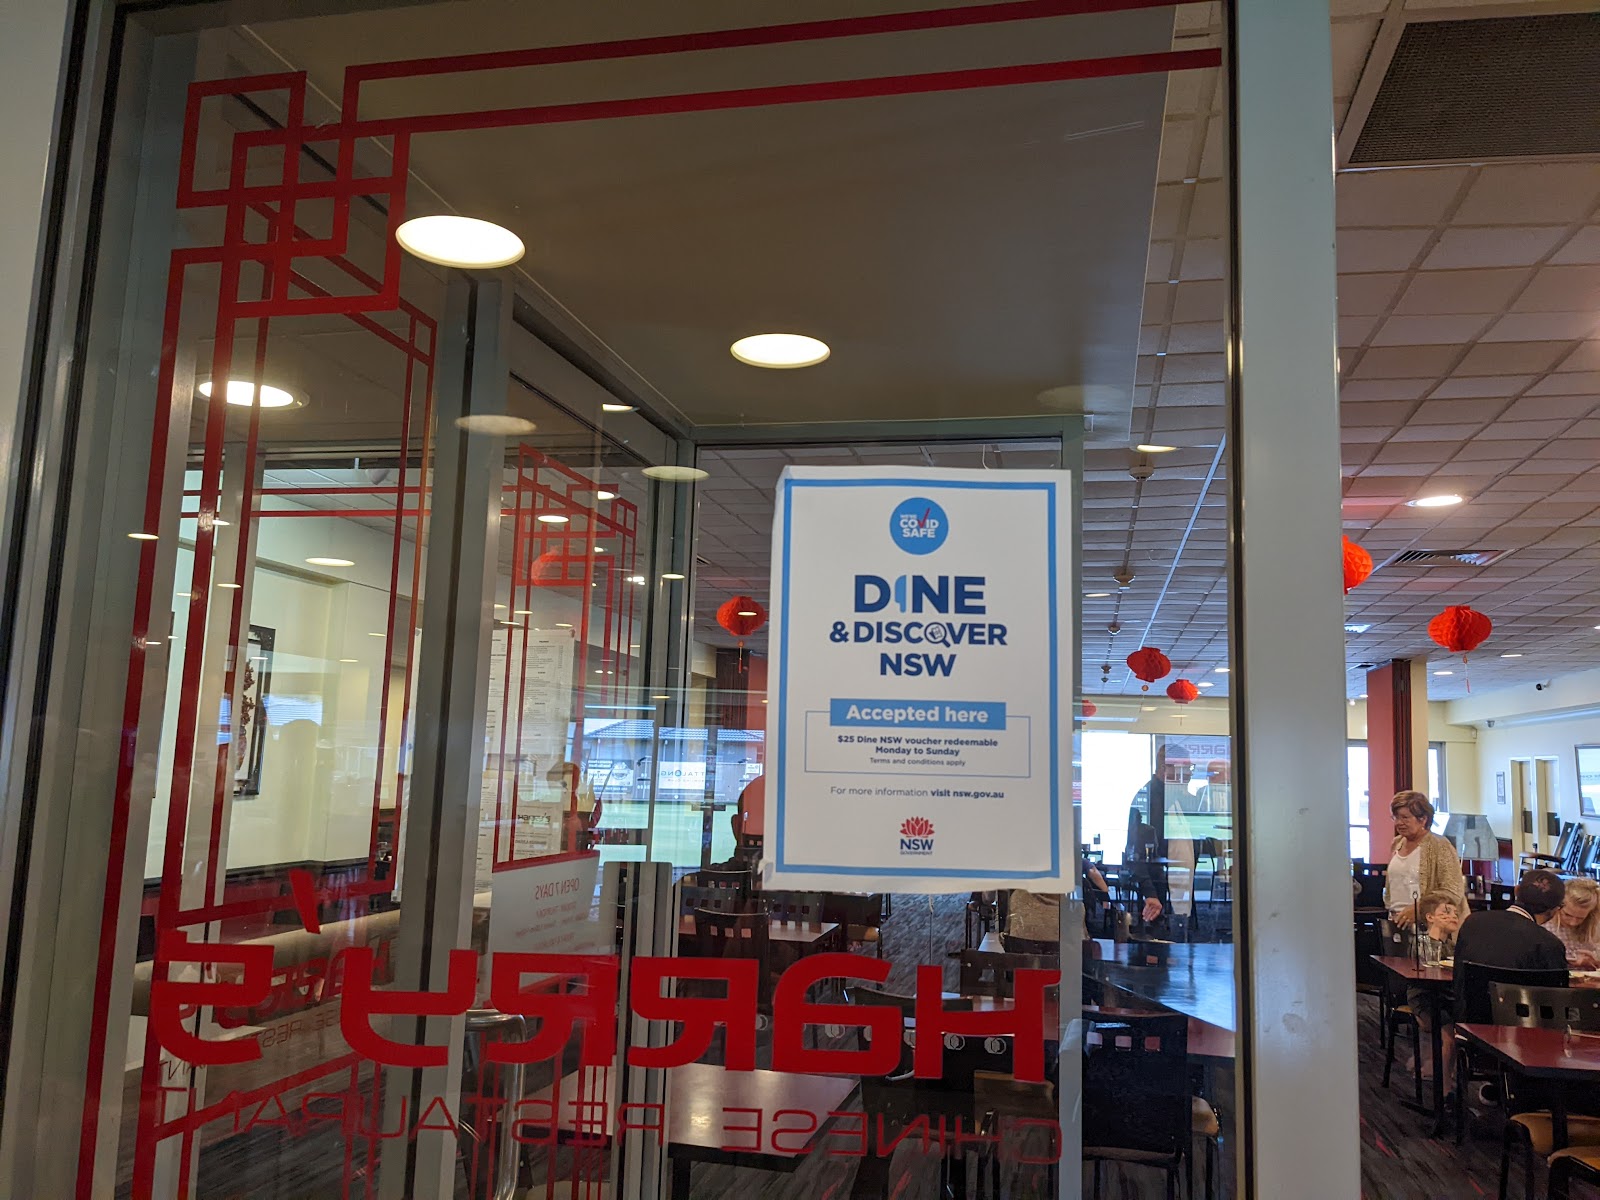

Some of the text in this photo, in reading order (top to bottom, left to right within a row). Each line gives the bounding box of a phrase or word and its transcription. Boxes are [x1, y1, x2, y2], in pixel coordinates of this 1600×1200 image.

[902, 528, 936, 538] SAFE
[854, 574, 986, 615] DINE
[829, 621, 1008, 648] & DISCOVER
[880, 652, 957, 677] NSW
[846, 704, 989, 723] Accepted here
[837, 735, 855, 743] $25
[880, 736, 902, 744] NSW
[944, 738, 998, 747] redeemable
[876, 746, 960, 756] Monday to Sunday
[830, 786, 1005, 799] For more information visit nsw.gov.au
[899, 838, 934, 850] NSW
